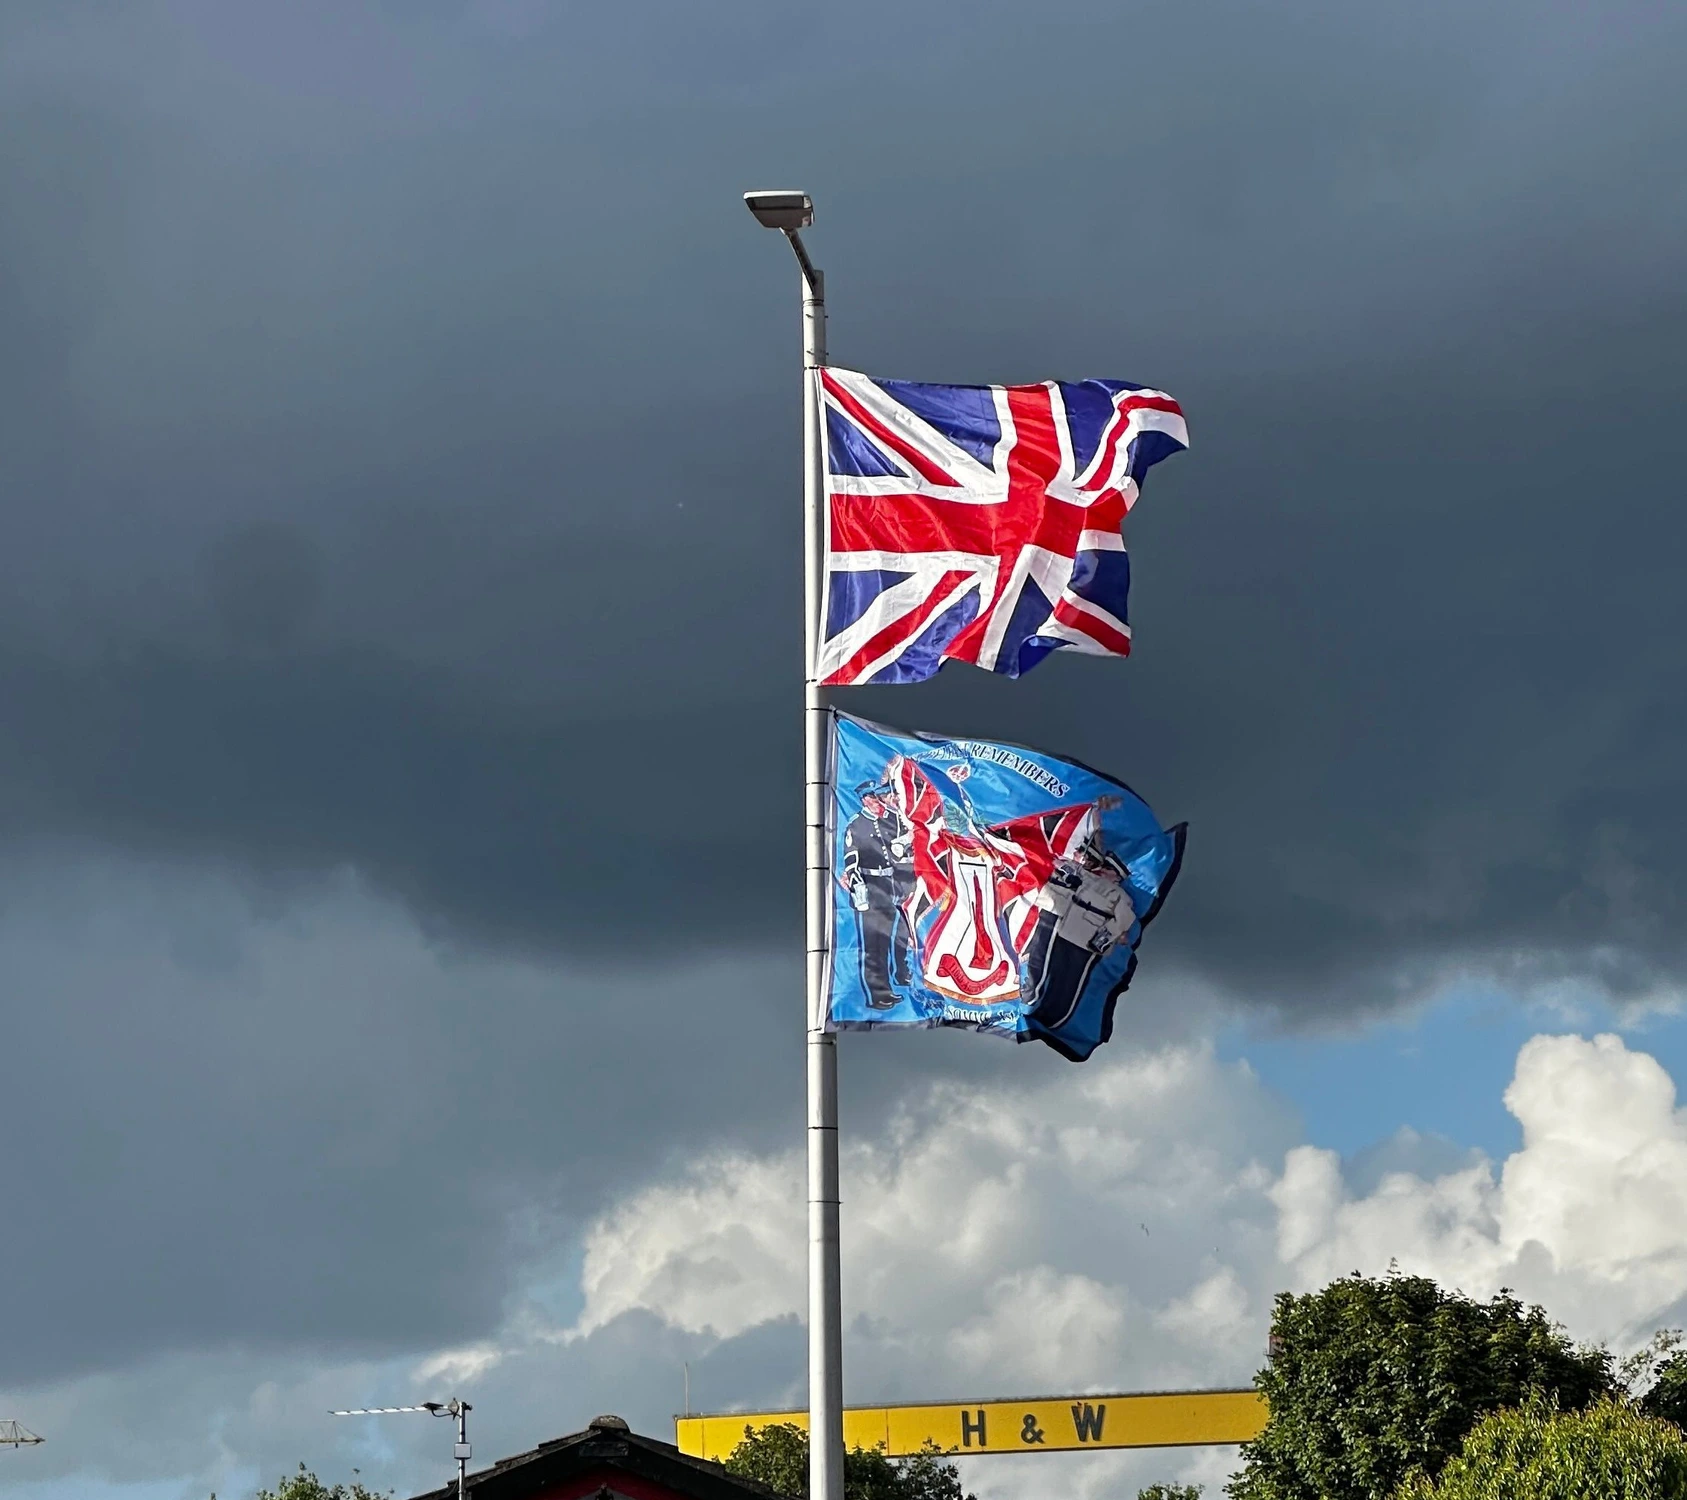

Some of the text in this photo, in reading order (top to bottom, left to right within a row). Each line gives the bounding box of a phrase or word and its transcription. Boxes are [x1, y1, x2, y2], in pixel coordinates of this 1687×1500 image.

[971, 742, 1070, 797] REMEMBERS
[961, 1404, 1105, 1447] H & W
